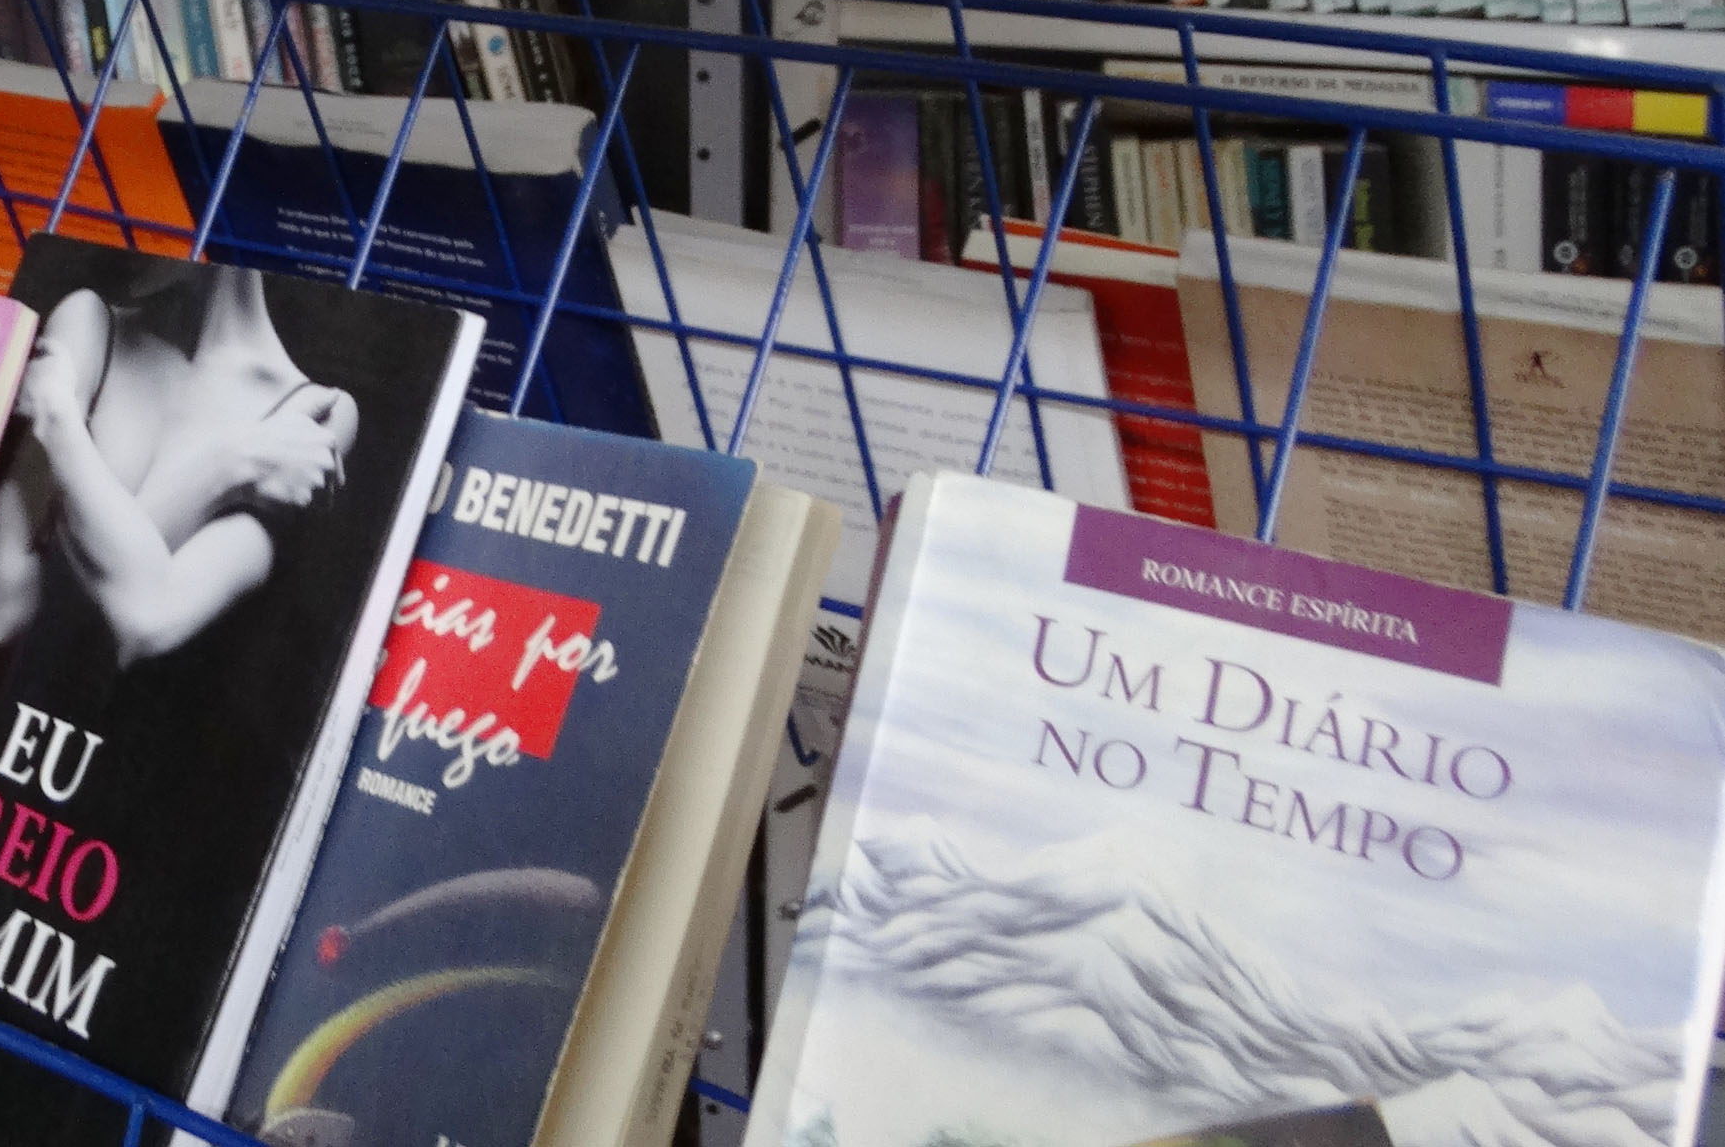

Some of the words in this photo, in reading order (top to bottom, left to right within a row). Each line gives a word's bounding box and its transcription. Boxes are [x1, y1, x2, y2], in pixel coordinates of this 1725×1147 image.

[453, 467, 687, 568] BENEDETTI
[1141, 558, 1286, 614] ROMANCE
[1288, 587, 1420, 647] ESPÍRITA
[513, 613, 619, 690] por
[356, 766, 438, 816] ROMANCE
[1030, 717, 1147, 792] NO
[1172, 736, 1466, 882] TEMPO
